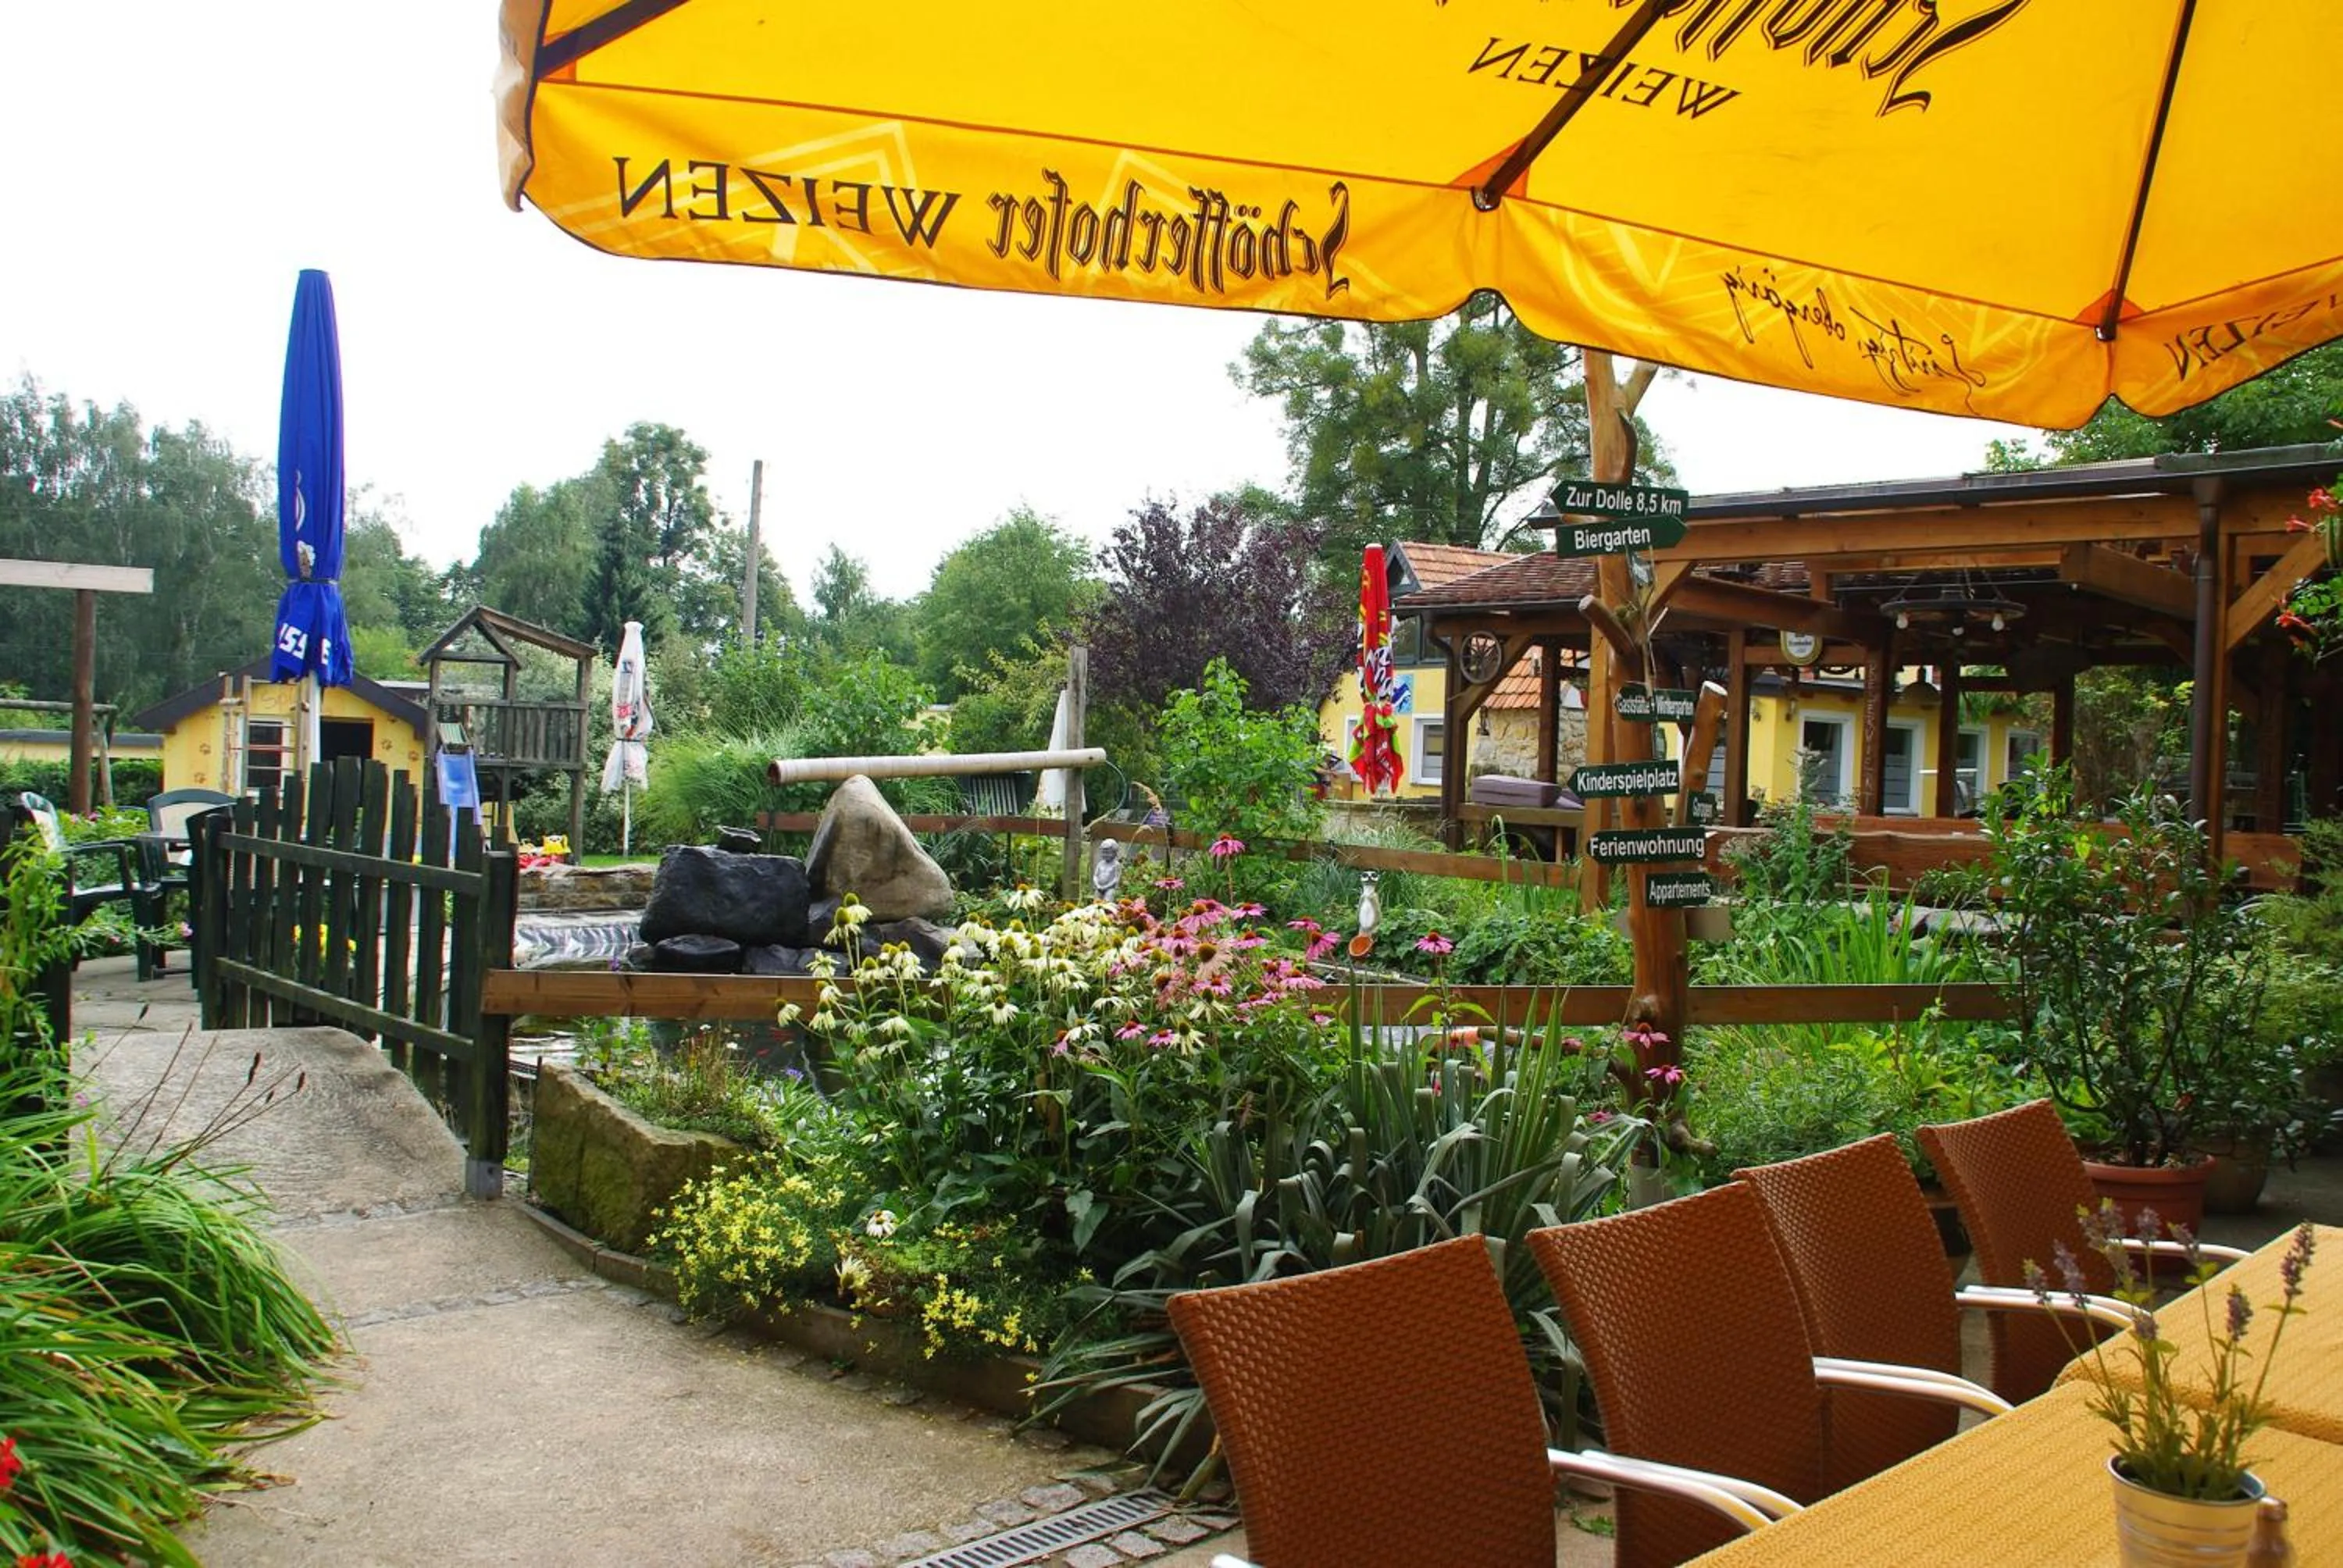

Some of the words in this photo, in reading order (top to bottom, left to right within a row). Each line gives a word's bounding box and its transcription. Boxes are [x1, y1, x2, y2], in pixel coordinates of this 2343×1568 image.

[1565, 486, 1592, 508] Zur
[1596, 488, 1633, 511] Dolle
[1636, 491, 1657, 516] 8,5
[1660, 494, 1682, 515] km
[1574, 526, 1651, 552] Biergarten
[1577, 768, 1678, 794] Kinderspielplatz
[1590, 835, 1705, 858] Ferienwohnung
[1649, 879, 1712, 904] Appartements
